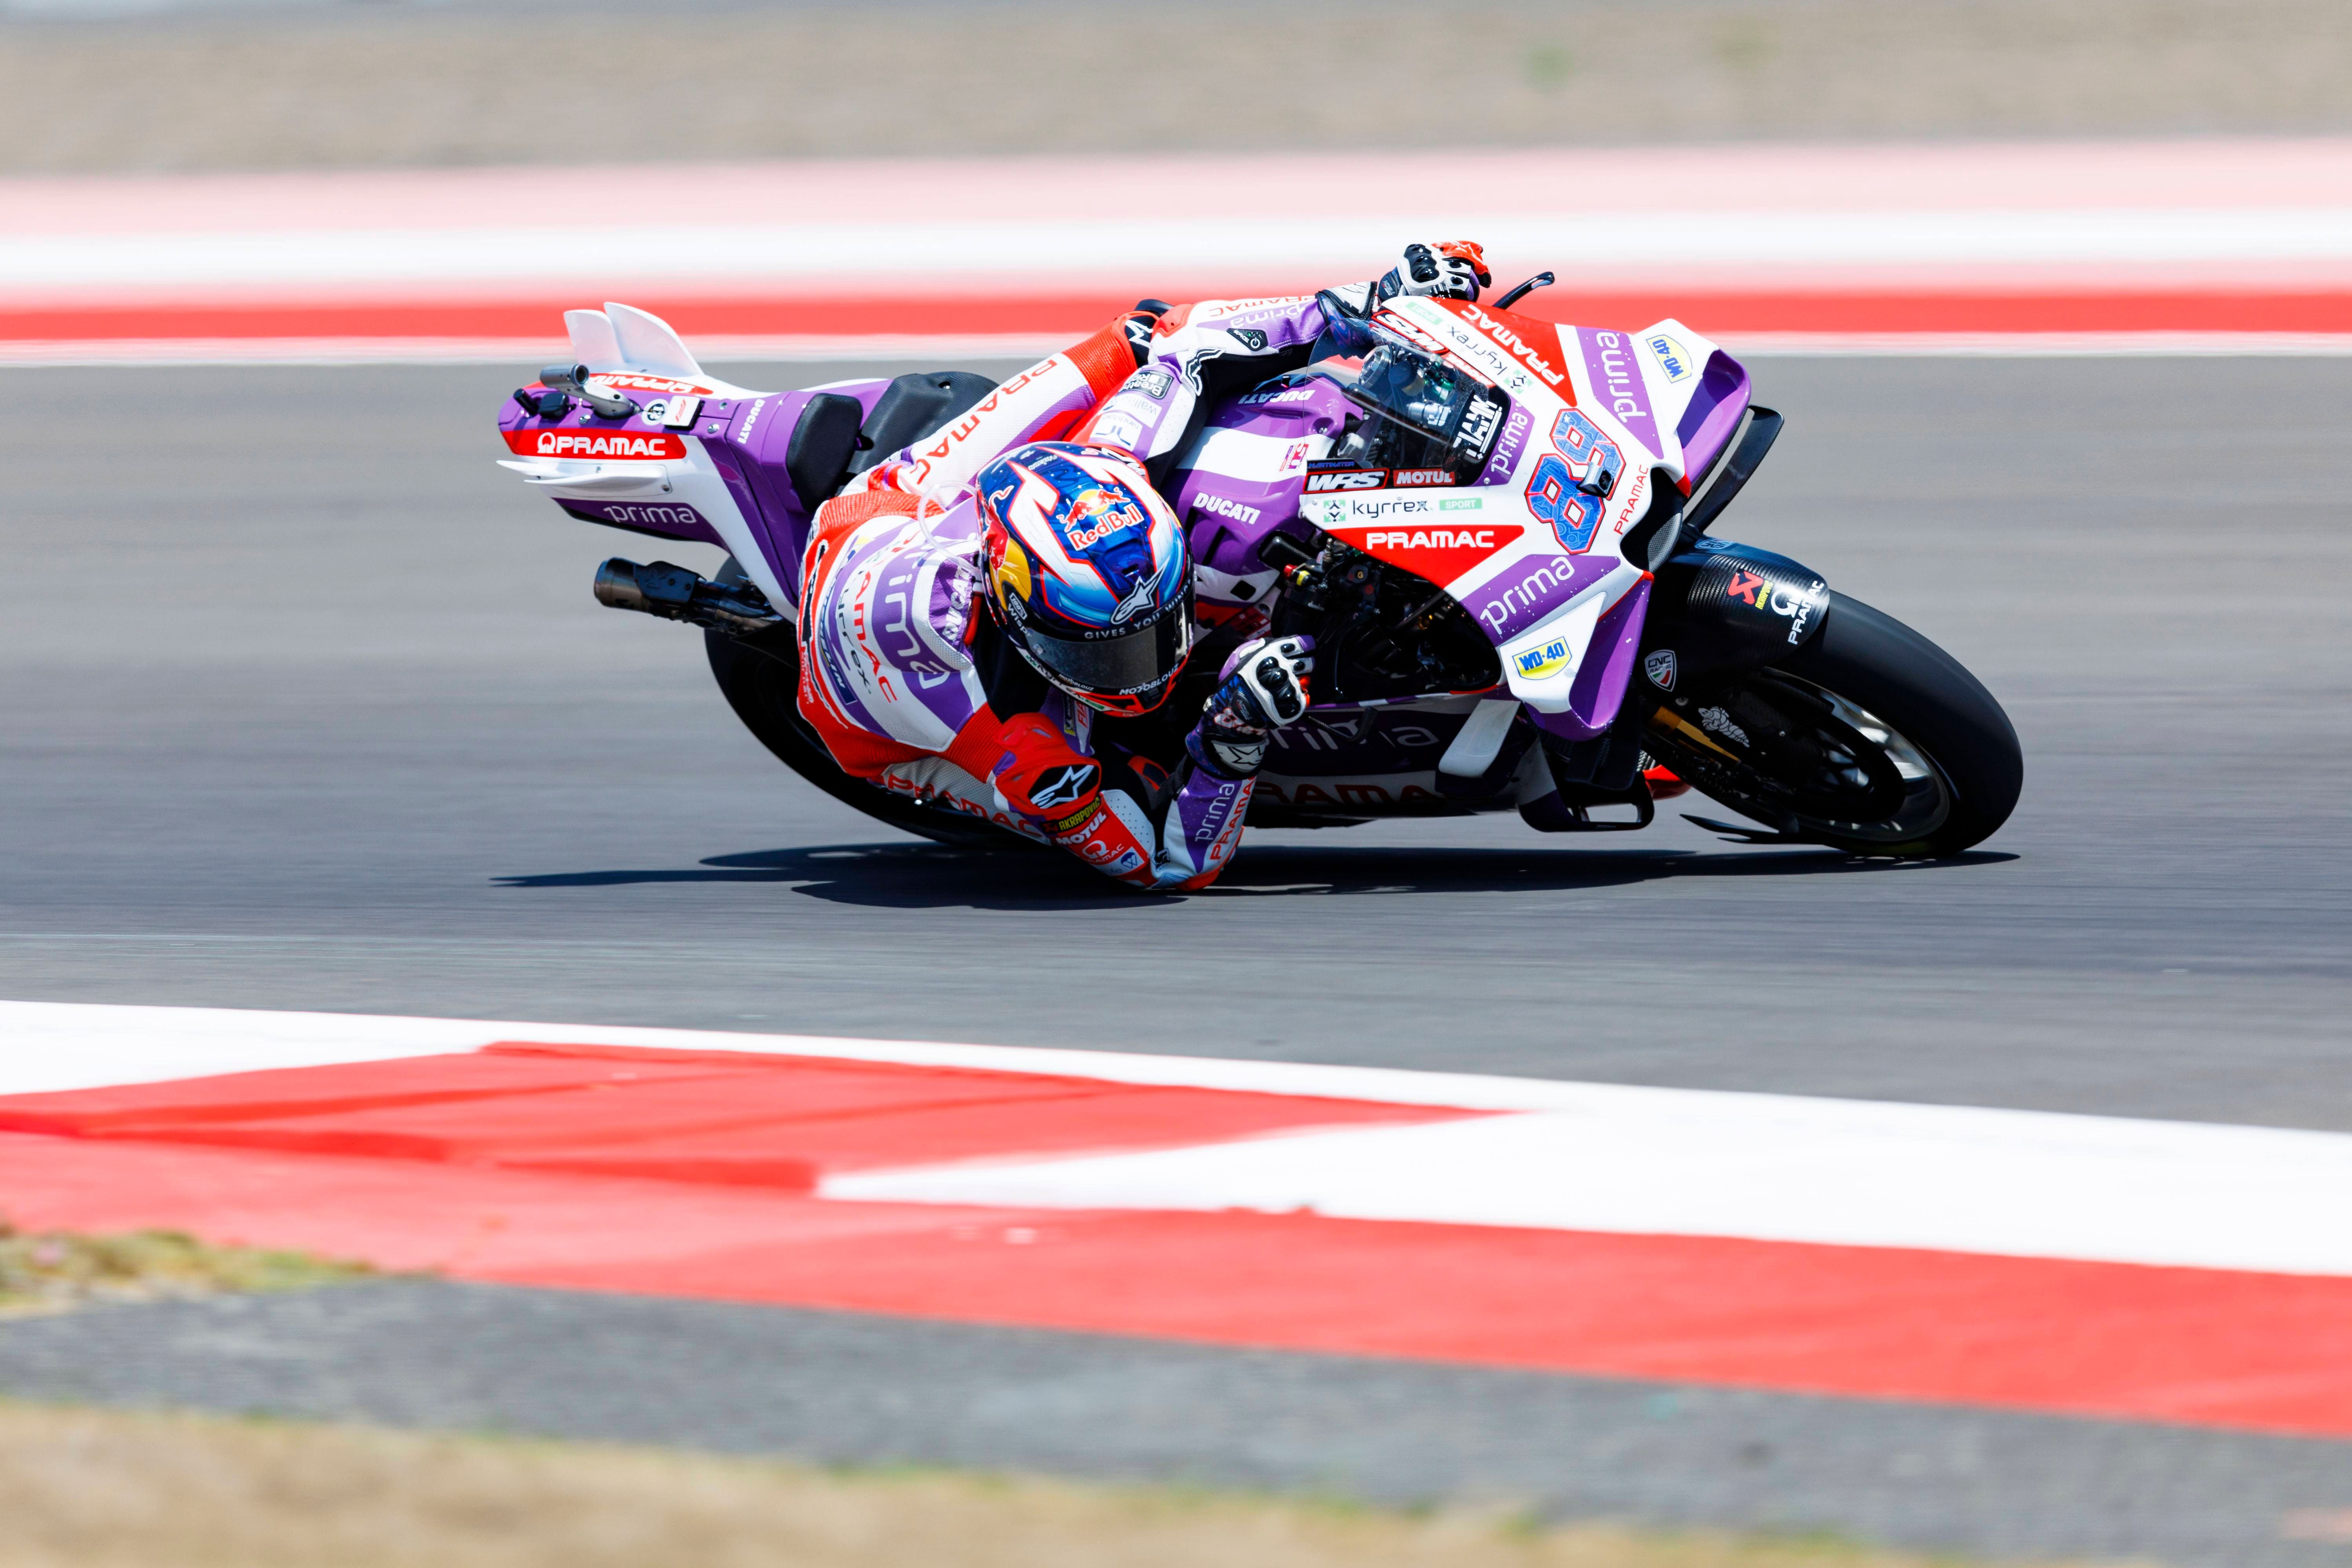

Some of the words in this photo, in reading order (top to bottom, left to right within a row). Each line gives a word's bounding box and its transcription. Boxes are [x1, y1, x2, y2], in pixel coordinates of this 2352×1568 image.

[1230, 304, 1306, 328] prima
[1376, 314, 1445, 351] WRS
[1446, 325, 1508, 376] kyrrex
[1461, 303, 1565, 385] PRAMAC
[1652, 339, 1685, 379] WD-40
[1596, 332, 1647, 423] prima
[1237, 390, 1316, 404] DUCATI
[738, 399, 765, 444] DUCATI
[909, 359, 1058, 485] PRAMAC
[556, 436, 665, 456] PRAMAC
[1491, 413, 1529, 475] prima
[1307, 470, 1386, 492] WRS
[1308, 460, 1355, 469] MARTINATOR
[1396, 470, 1453, 485] MOTUL
[1524, 408, 1626, 554] 89
[604, 505, 697, 524] prima
[1192, 492, 1261, 524] DUCATI
[1352, 500, 1428, 518] kyrrex
[1446, 500, 1477, 508] SPORT
[1613, 464, 1649, 536] PRAMAC
[1069, 516, 1110, 549] Red
[1107, 505, 1142, 529] Bull
[1367, 531, 1495, 549] PRAMAC
[1480, 557, 1575, 635] prima
[1788, 580, 1825, 645] PRAMAC
[1008, 603, 1032, 637] wispr
[1084, 628, 1126, 639] GIVES
[1134, 613, 1160, 630] YOU
[1519, 642, 1565, 671] WD-40
[1648, 655, 1671, 668] CNC
[1119, 663, 1178, 695] MOTOBLOUZ
[1056, 811, 1106, 844] MOTUL
[1195, 784, 1235, 842] prima
